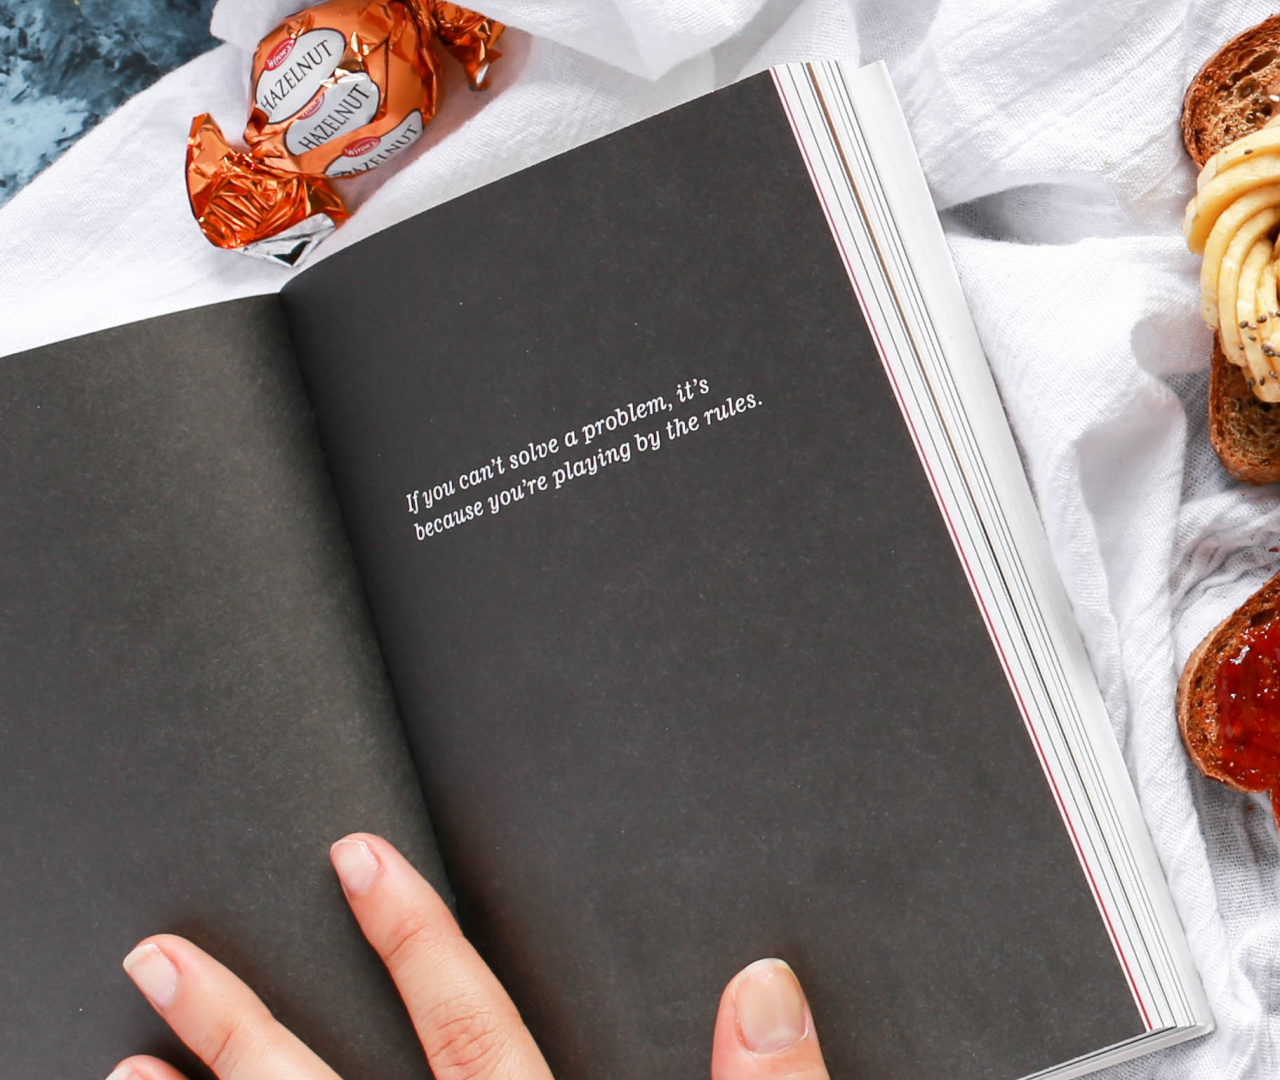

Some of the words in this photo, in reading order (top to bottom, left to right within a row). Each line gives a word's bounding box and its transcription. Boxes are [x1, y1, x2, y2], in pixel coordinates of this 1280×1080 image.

[260, 39, 334, 111] HAZELNUT
[298, 83, 370, 150] HAZELNUT
[406, 491, 421, 515] If
[423, 481, 457, 510] you
[459, 456, 506, 491] can't
[509, 439, 560, 472] solve
[564, 430, 579, 448] a
[582, 396, 674, 446] problem,
[676, 378, 711, 404] it's
[414, 501, 485, 542] because
[487, 475, 550, 517] you're
[551, 441, 633, 491] playing
[634, 429, 662, 453] by
[665, 415, 701, 441] the
[703, 392, 764, 426] rules.
